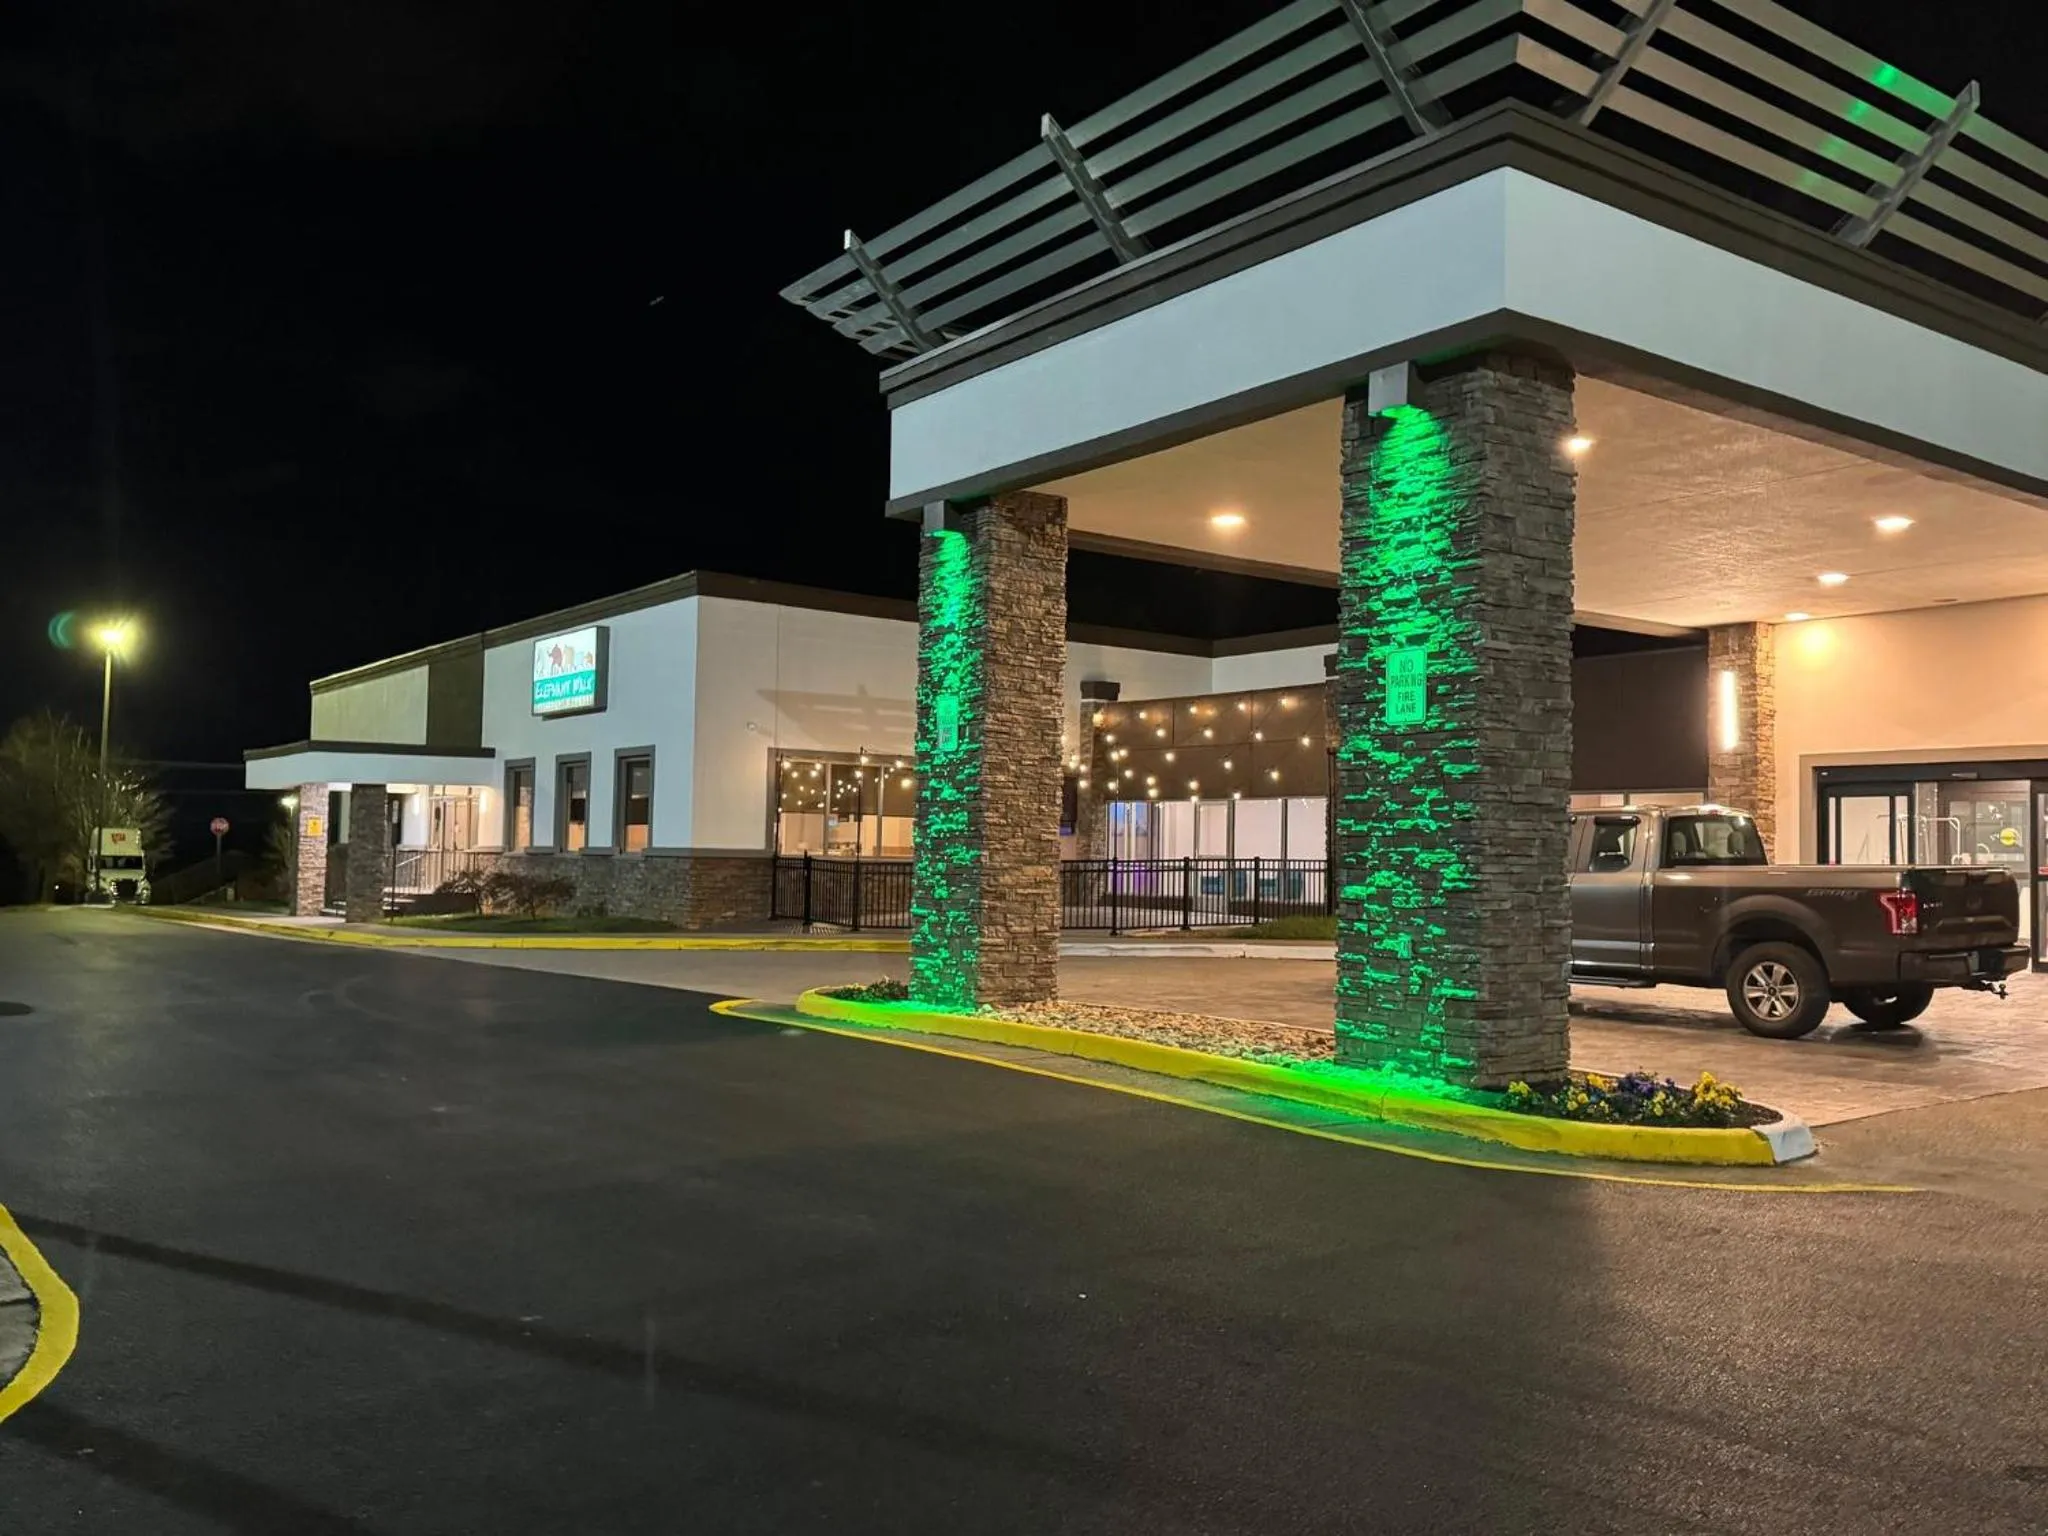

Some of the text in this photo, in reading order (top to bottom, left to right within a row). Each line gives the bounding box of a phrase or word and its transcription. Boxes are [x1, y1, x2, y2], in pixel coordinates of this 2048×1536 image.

[1399, 659, 1414, 673] NO
[1390, 673, 1423, 688] PARKING
[1397, 691, 1416, 702] FIRE
[1395, 703, 1417, 715] LANE
